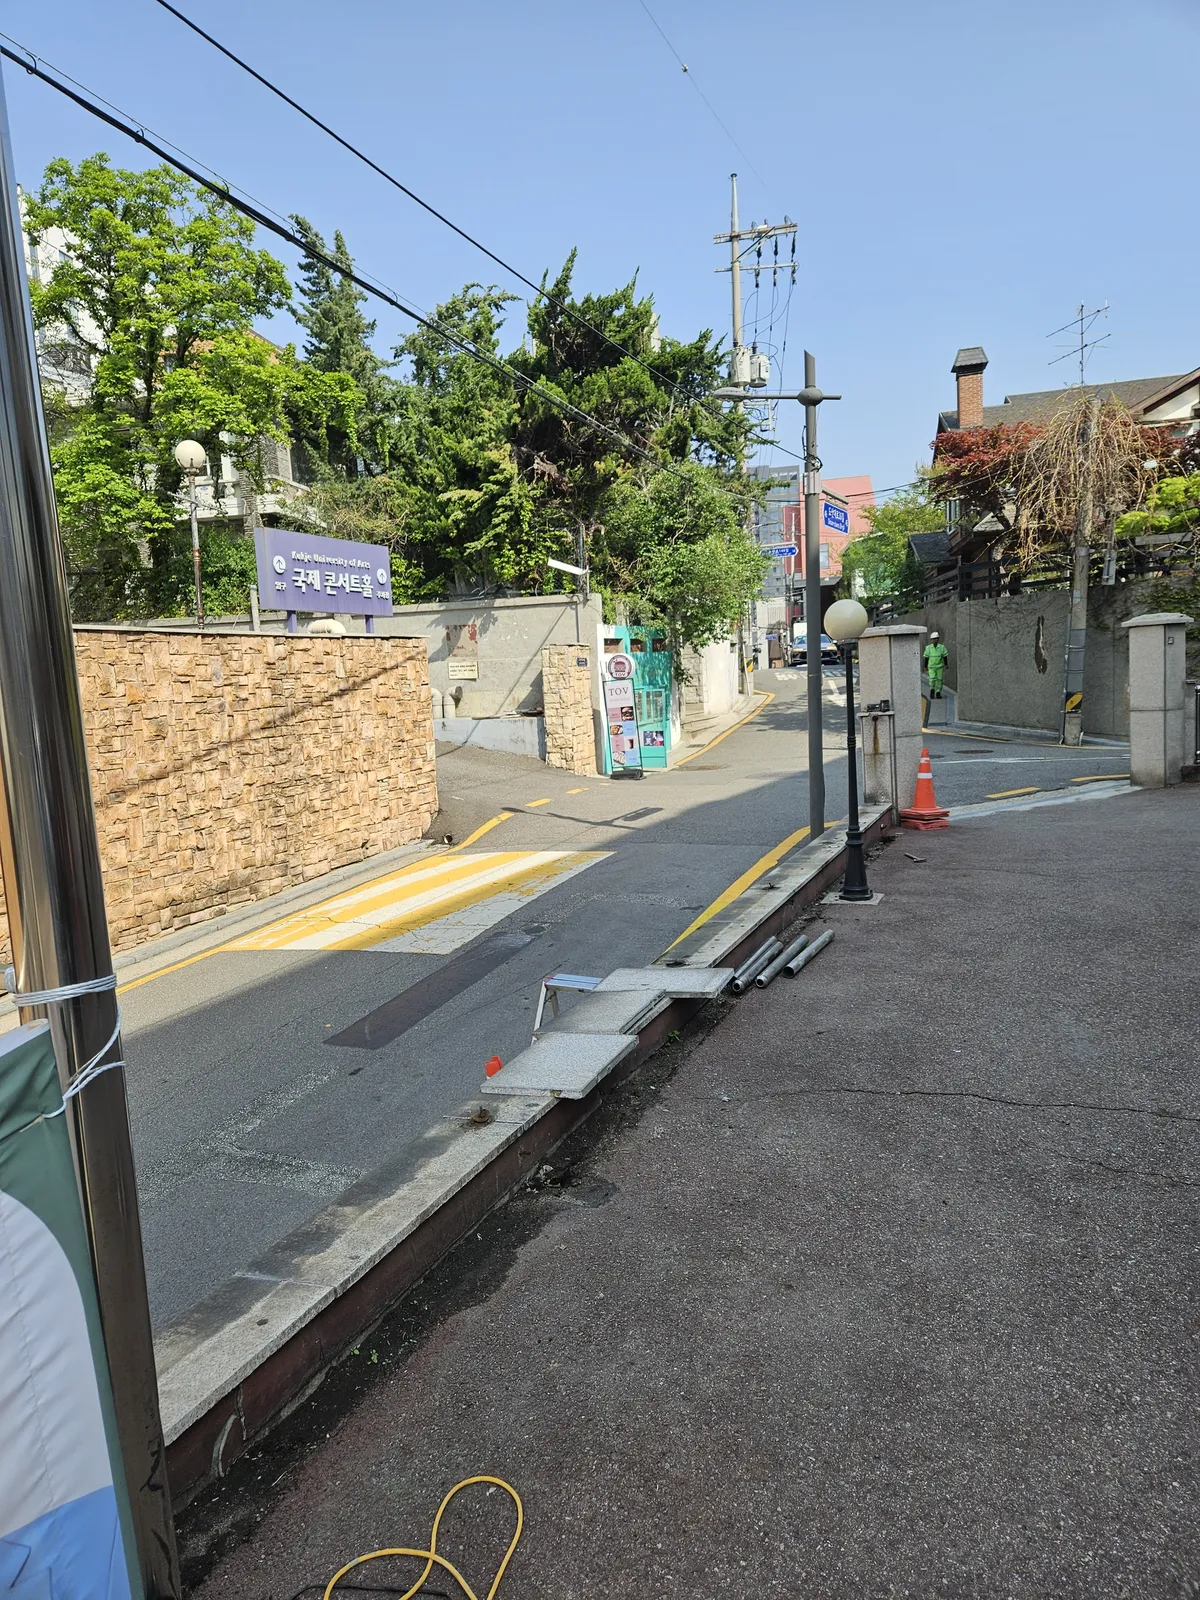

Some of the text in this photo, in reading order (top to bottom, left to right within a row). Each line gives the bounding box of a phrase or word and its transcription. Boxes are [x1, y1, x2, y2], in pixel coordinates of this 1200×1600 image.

[291, 551, 371, 569] Kukje University of Arts
[292, 568, 374, 598] 국제 콘서트홀
[608, 687, 629, 696] TOV
